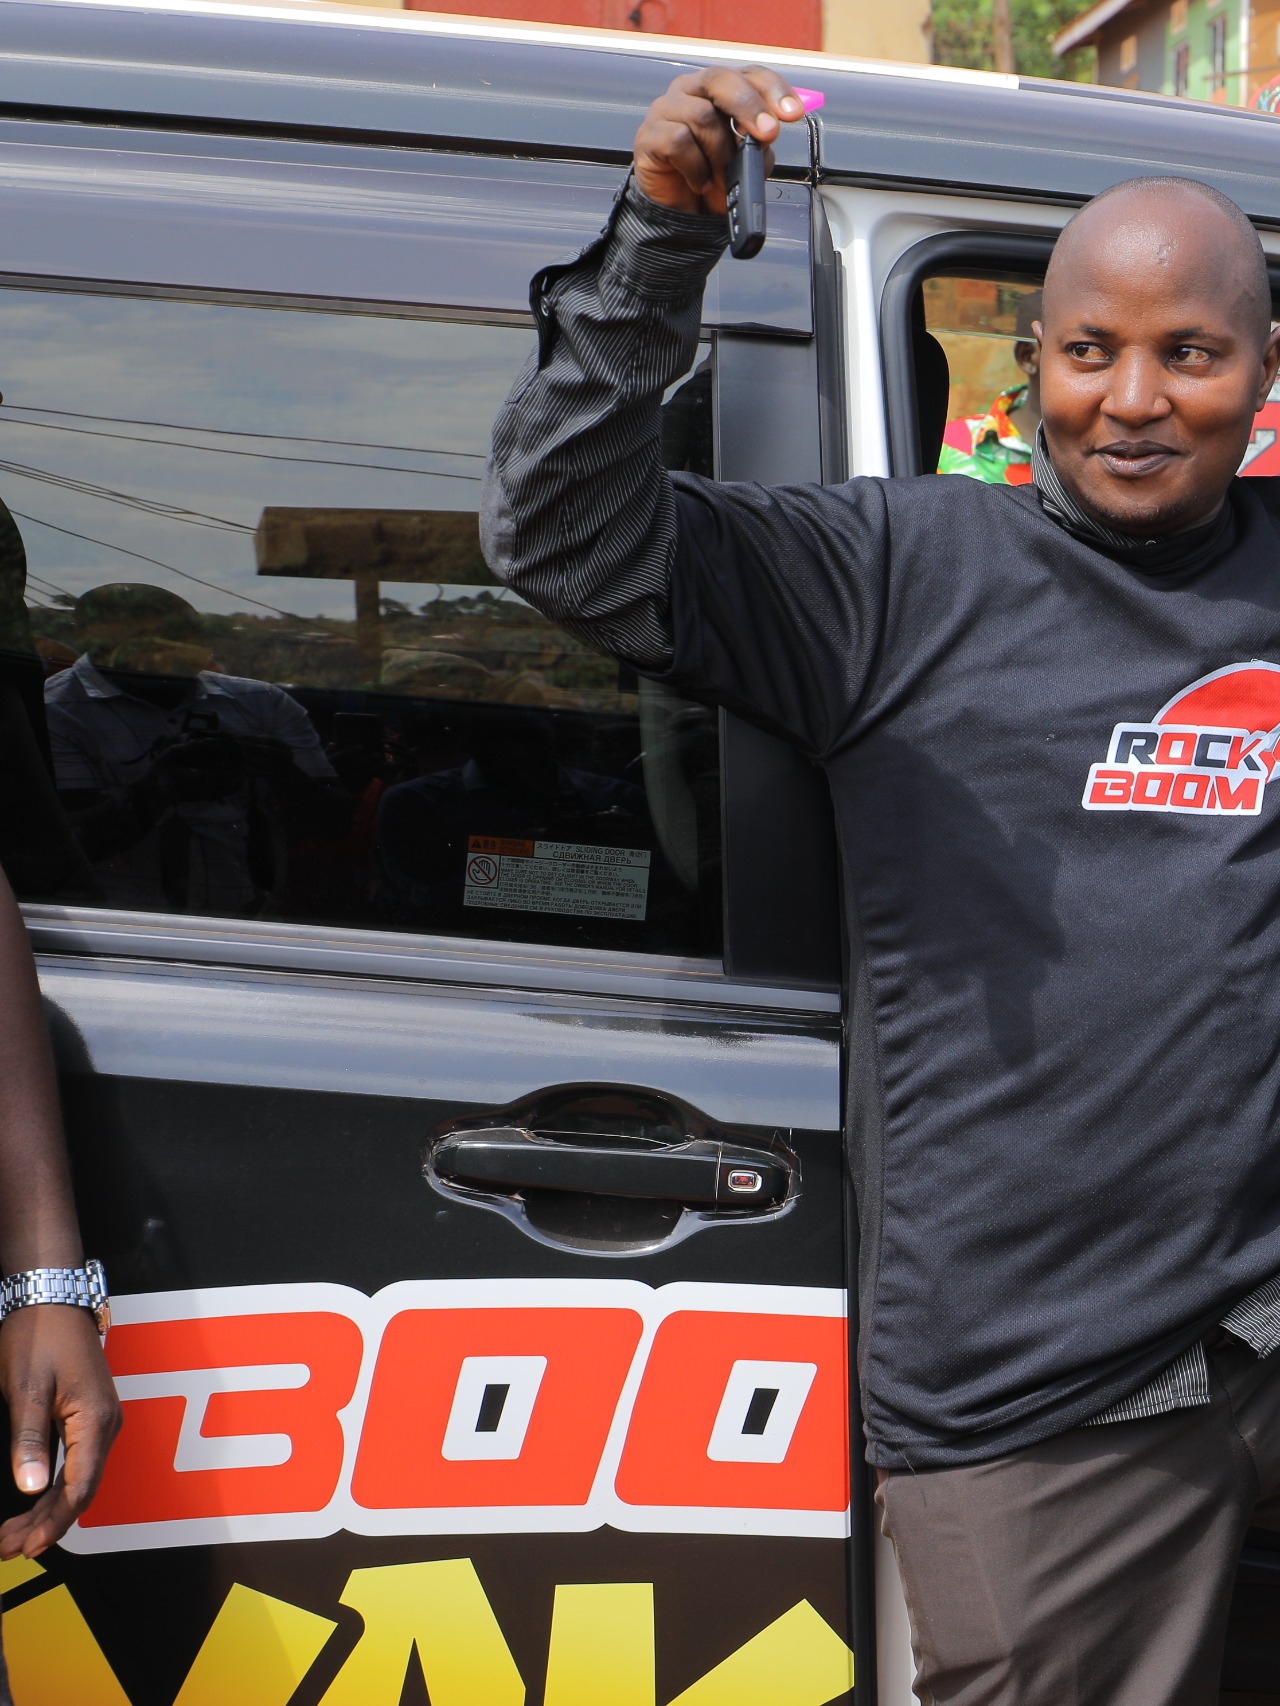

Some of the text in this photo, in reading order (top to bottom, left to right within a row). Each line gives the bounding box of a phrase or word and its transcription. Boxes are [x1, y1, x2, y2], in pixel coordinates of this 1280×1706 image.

[1114, 731, 1262, 771] ROCK
[1088, 769, 1260, 810] BOOM
[553, 851, 633, 865] СДВИЖНАЯ ДВЕРЬ
[576, 846, 626, 857] SLIDING DOOR
